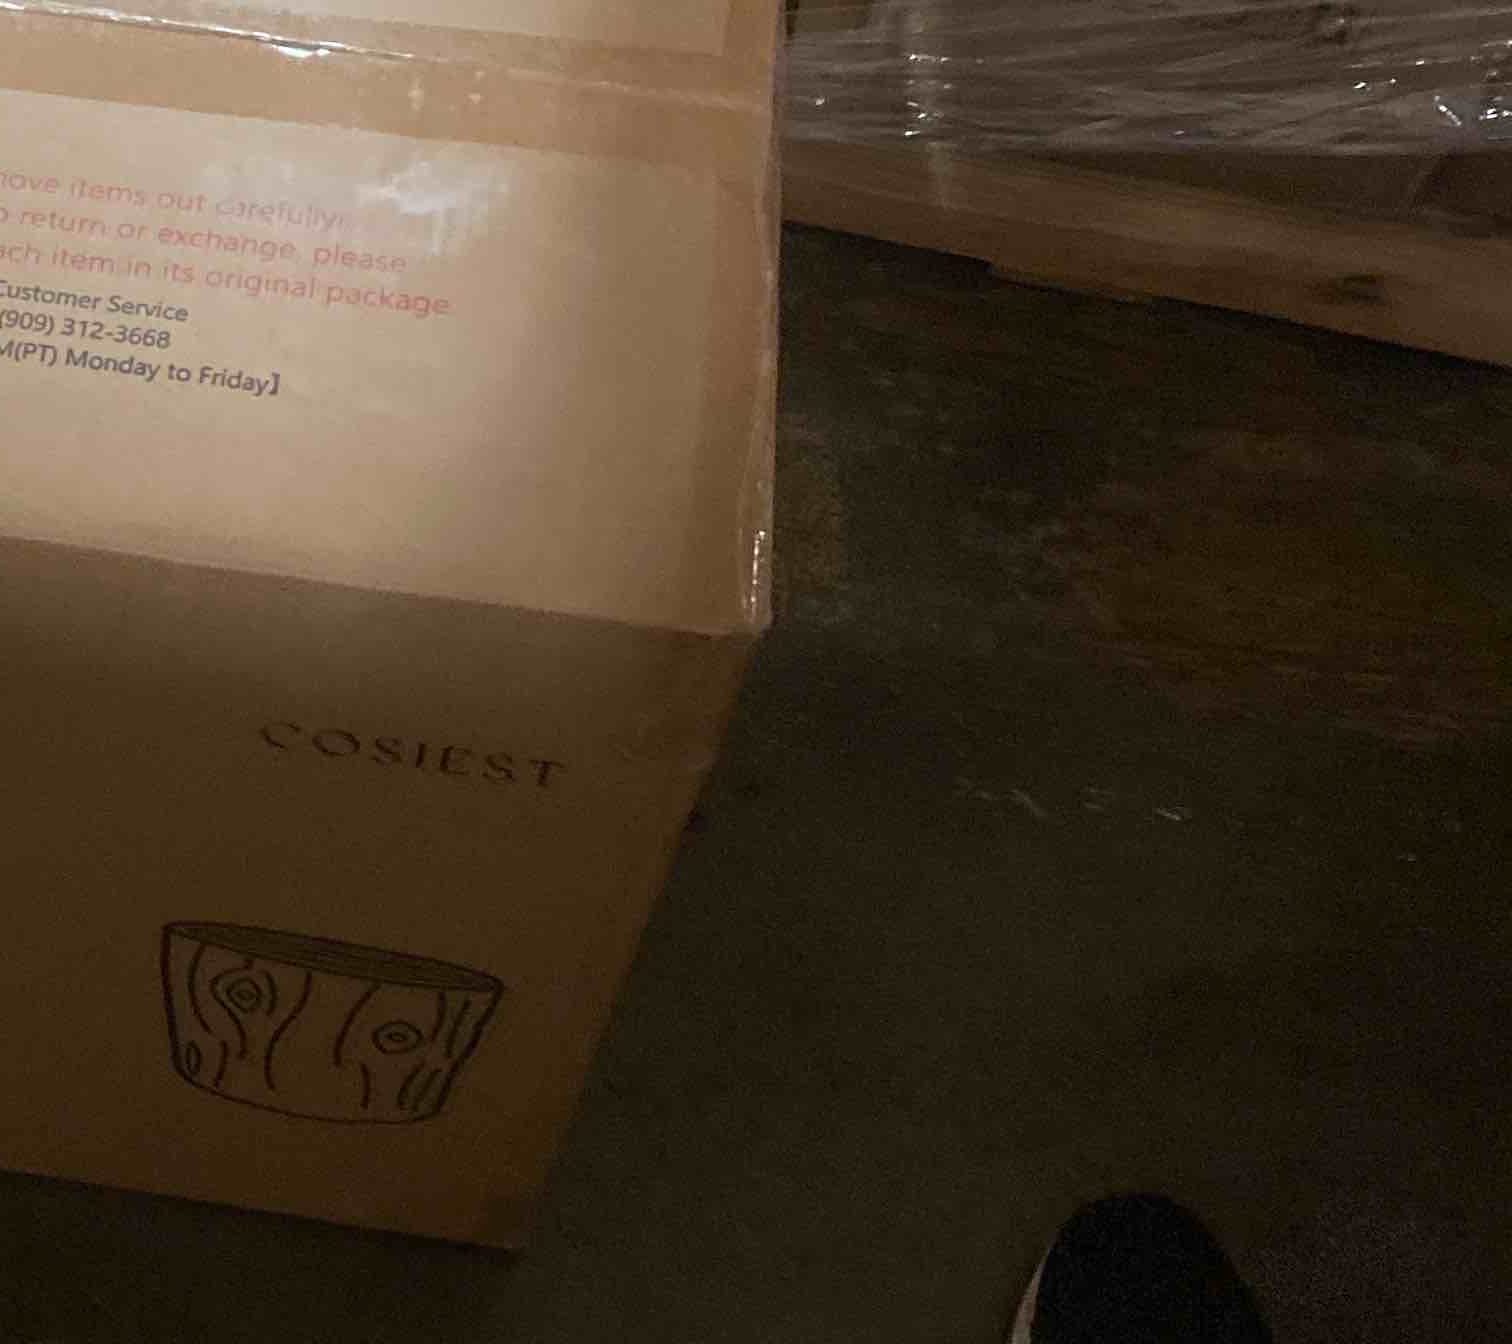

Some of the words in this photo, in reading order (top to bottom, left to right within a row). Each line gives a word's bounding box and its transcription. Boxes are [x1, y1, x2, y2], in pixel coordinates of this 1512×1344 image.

[69, 182, 145, 207] items
[156, 190, 208, 213] out
[18, 209, 110, 236] return
[118, 220, 147, 240] or
[313, 243, 408, 274] please
[51, 249, 119, 274] item
[125, 256, 152, 279] in
[162, 261, 195, 285] its
[205, 268, 318, 299] original
[105, 294, 189, 323] Service
[60, 318, 171, 350] 312-3668
[64, 347, 161, 383] Monday
[167, 362, 192, 384] to
[258, 720, 565, 787] COSIEST
